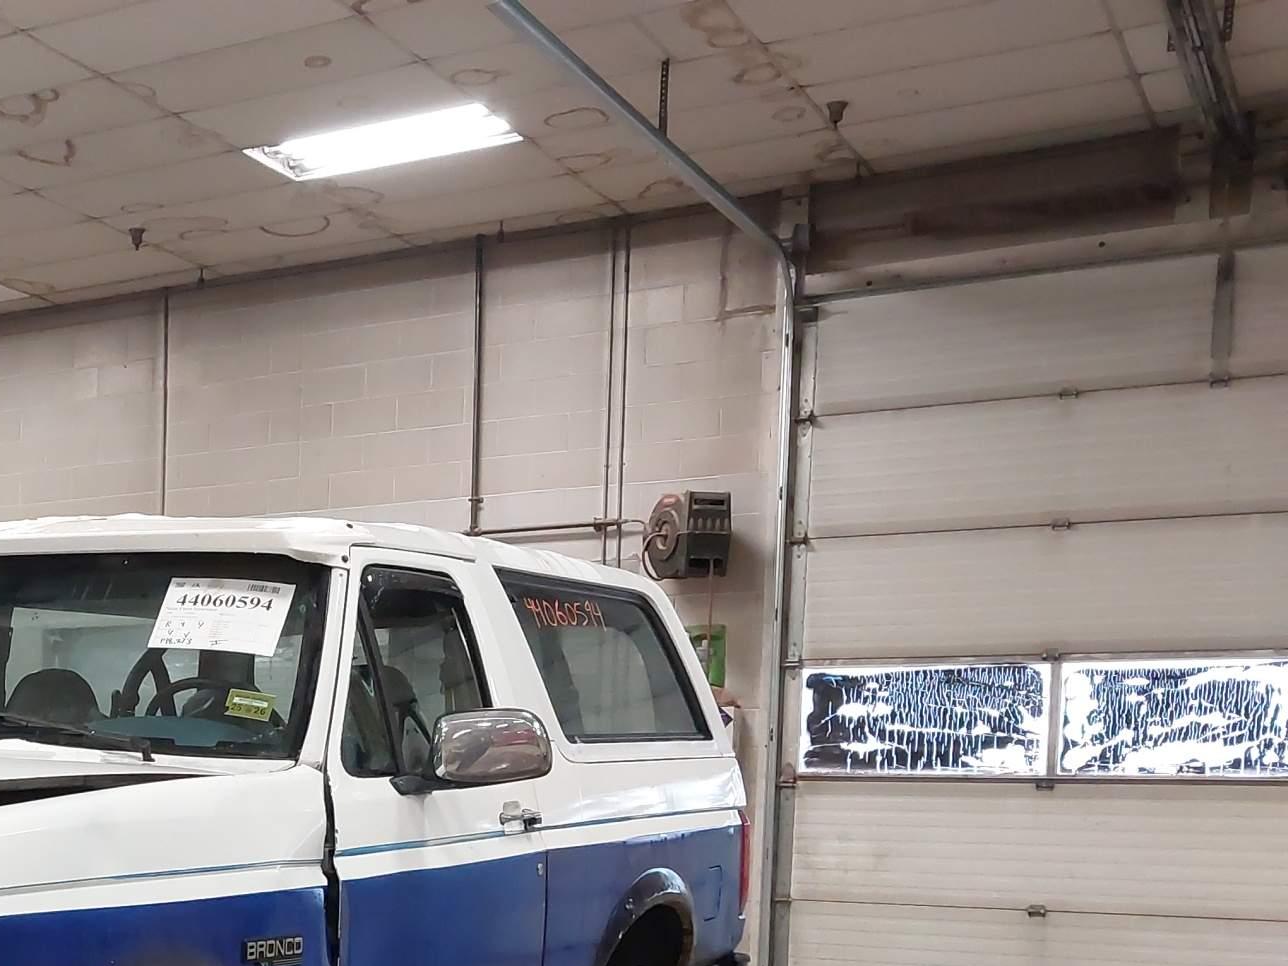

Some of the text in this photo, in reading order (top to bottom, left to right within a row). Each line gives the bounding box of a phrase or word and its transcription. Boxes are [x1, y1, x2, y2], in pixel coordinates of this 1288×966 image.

[177, 594, 274, 611] 44060594
[523, 597, 608, 632] 44060594
[247, 937, 303, 960] BRONCO
